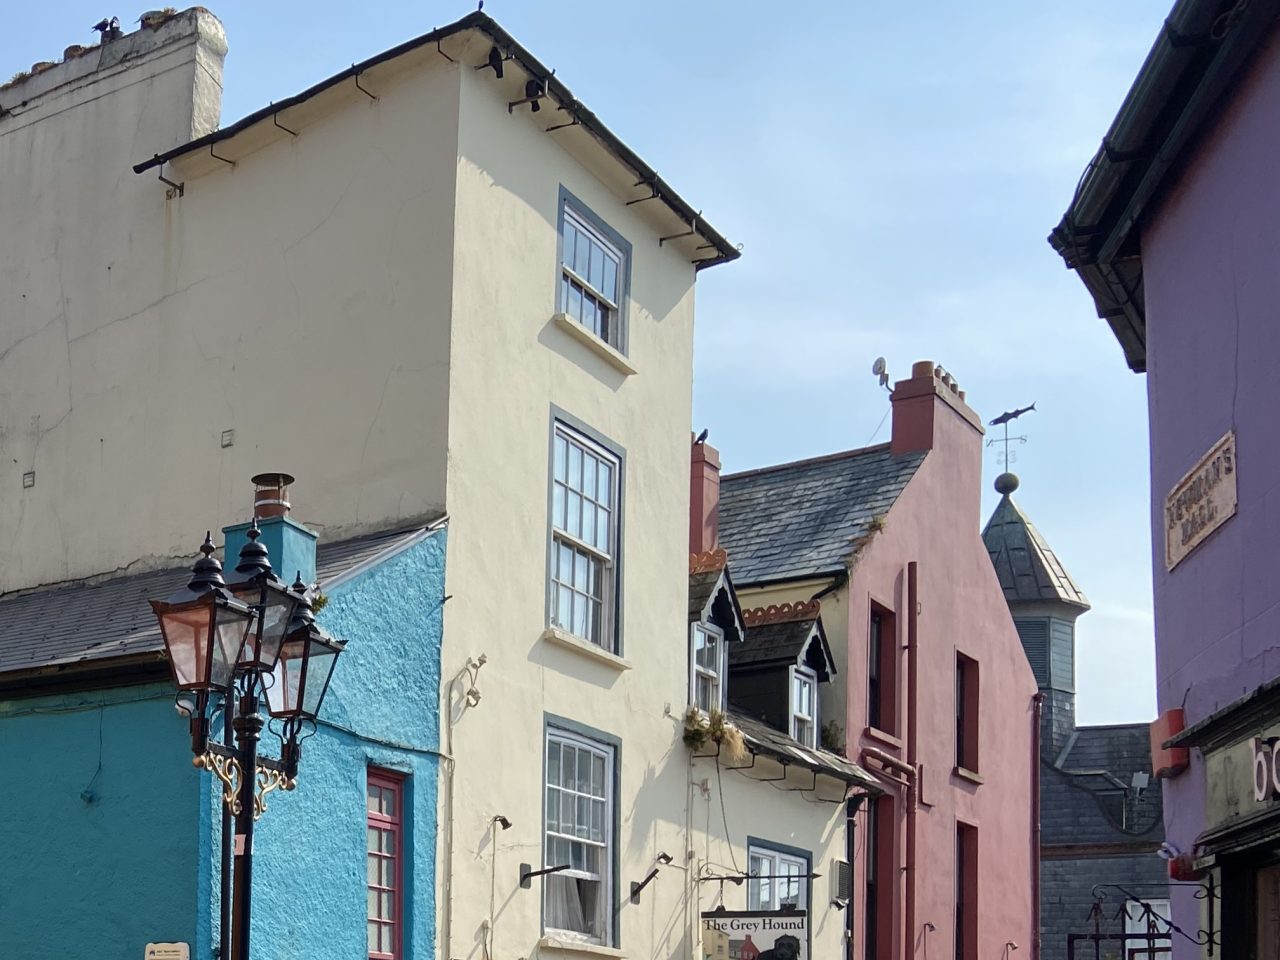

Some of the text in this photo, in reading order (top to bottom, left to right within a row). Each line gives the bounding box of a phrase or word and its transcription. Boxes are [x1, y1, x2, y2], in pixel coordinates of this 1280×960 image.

[703, 917, 805, 932] The Grey Hound
